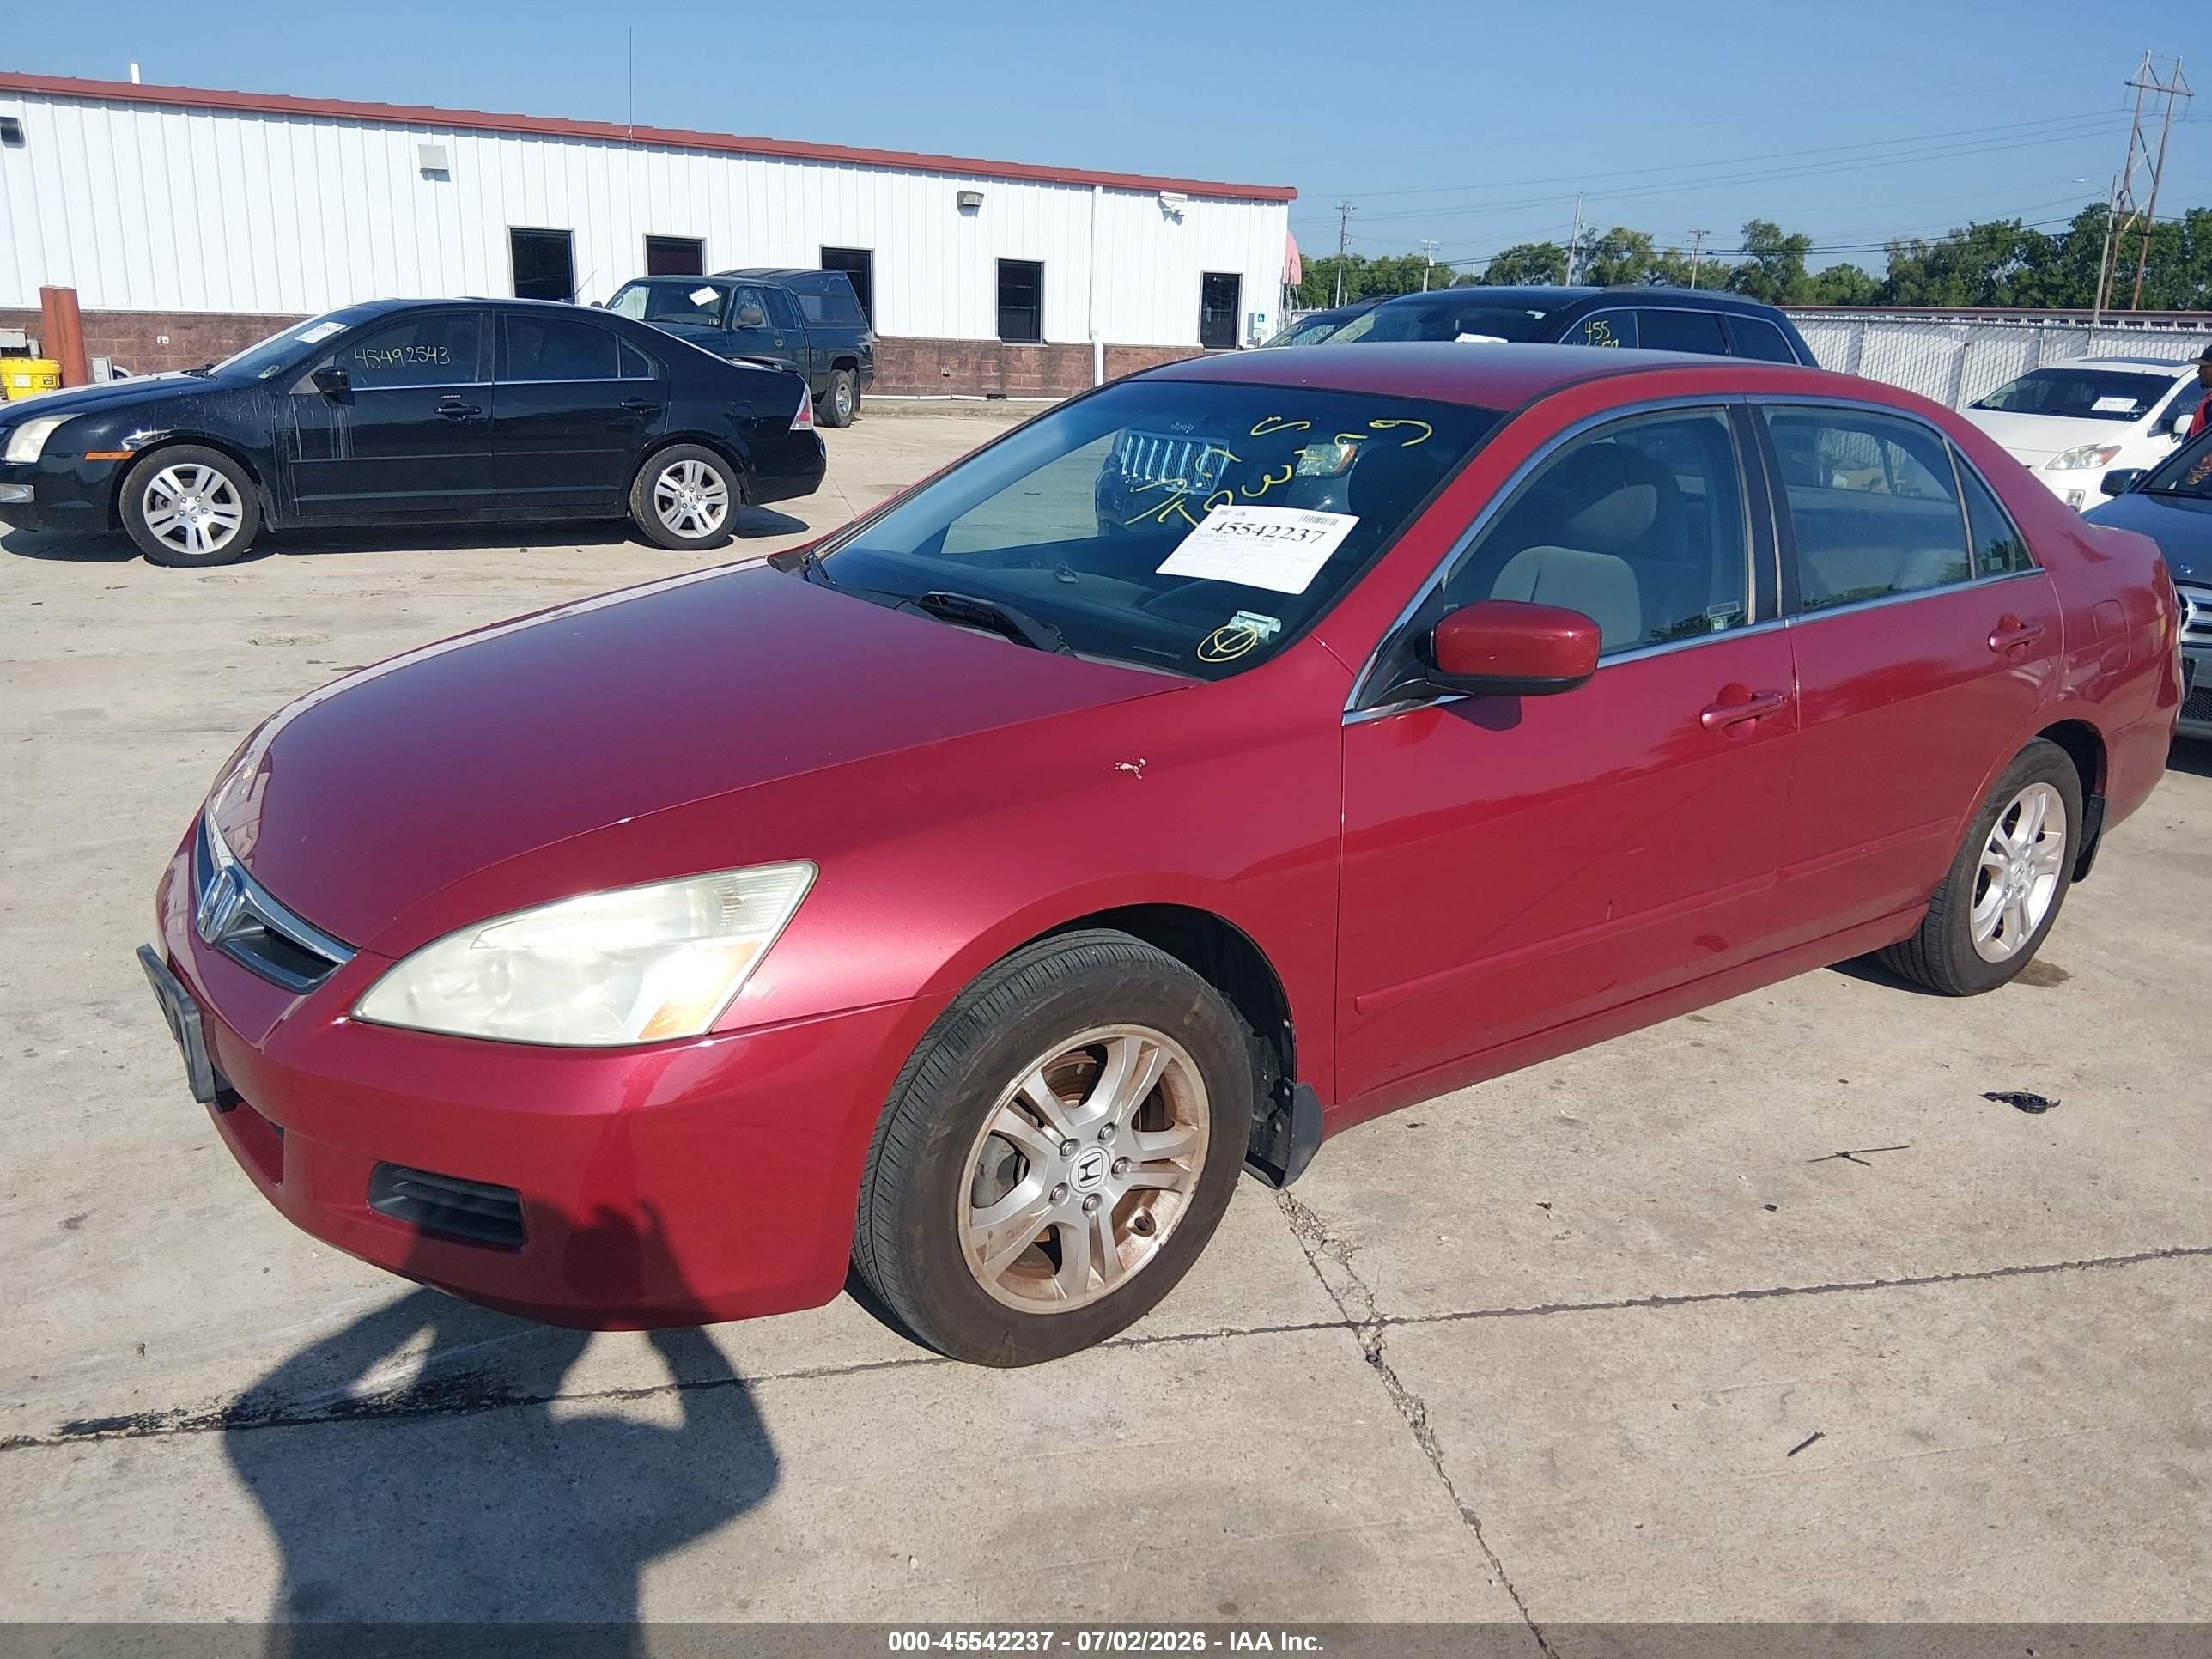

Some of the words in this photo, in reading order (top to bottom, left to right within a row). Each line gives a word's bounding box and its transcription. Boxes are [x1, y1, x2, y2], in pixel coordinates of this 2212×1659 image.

[1584, 320, 1611, 343] 455
[354, 345, 452, 369] 45492543
[1211, 521, 1328, 544] 45542237
